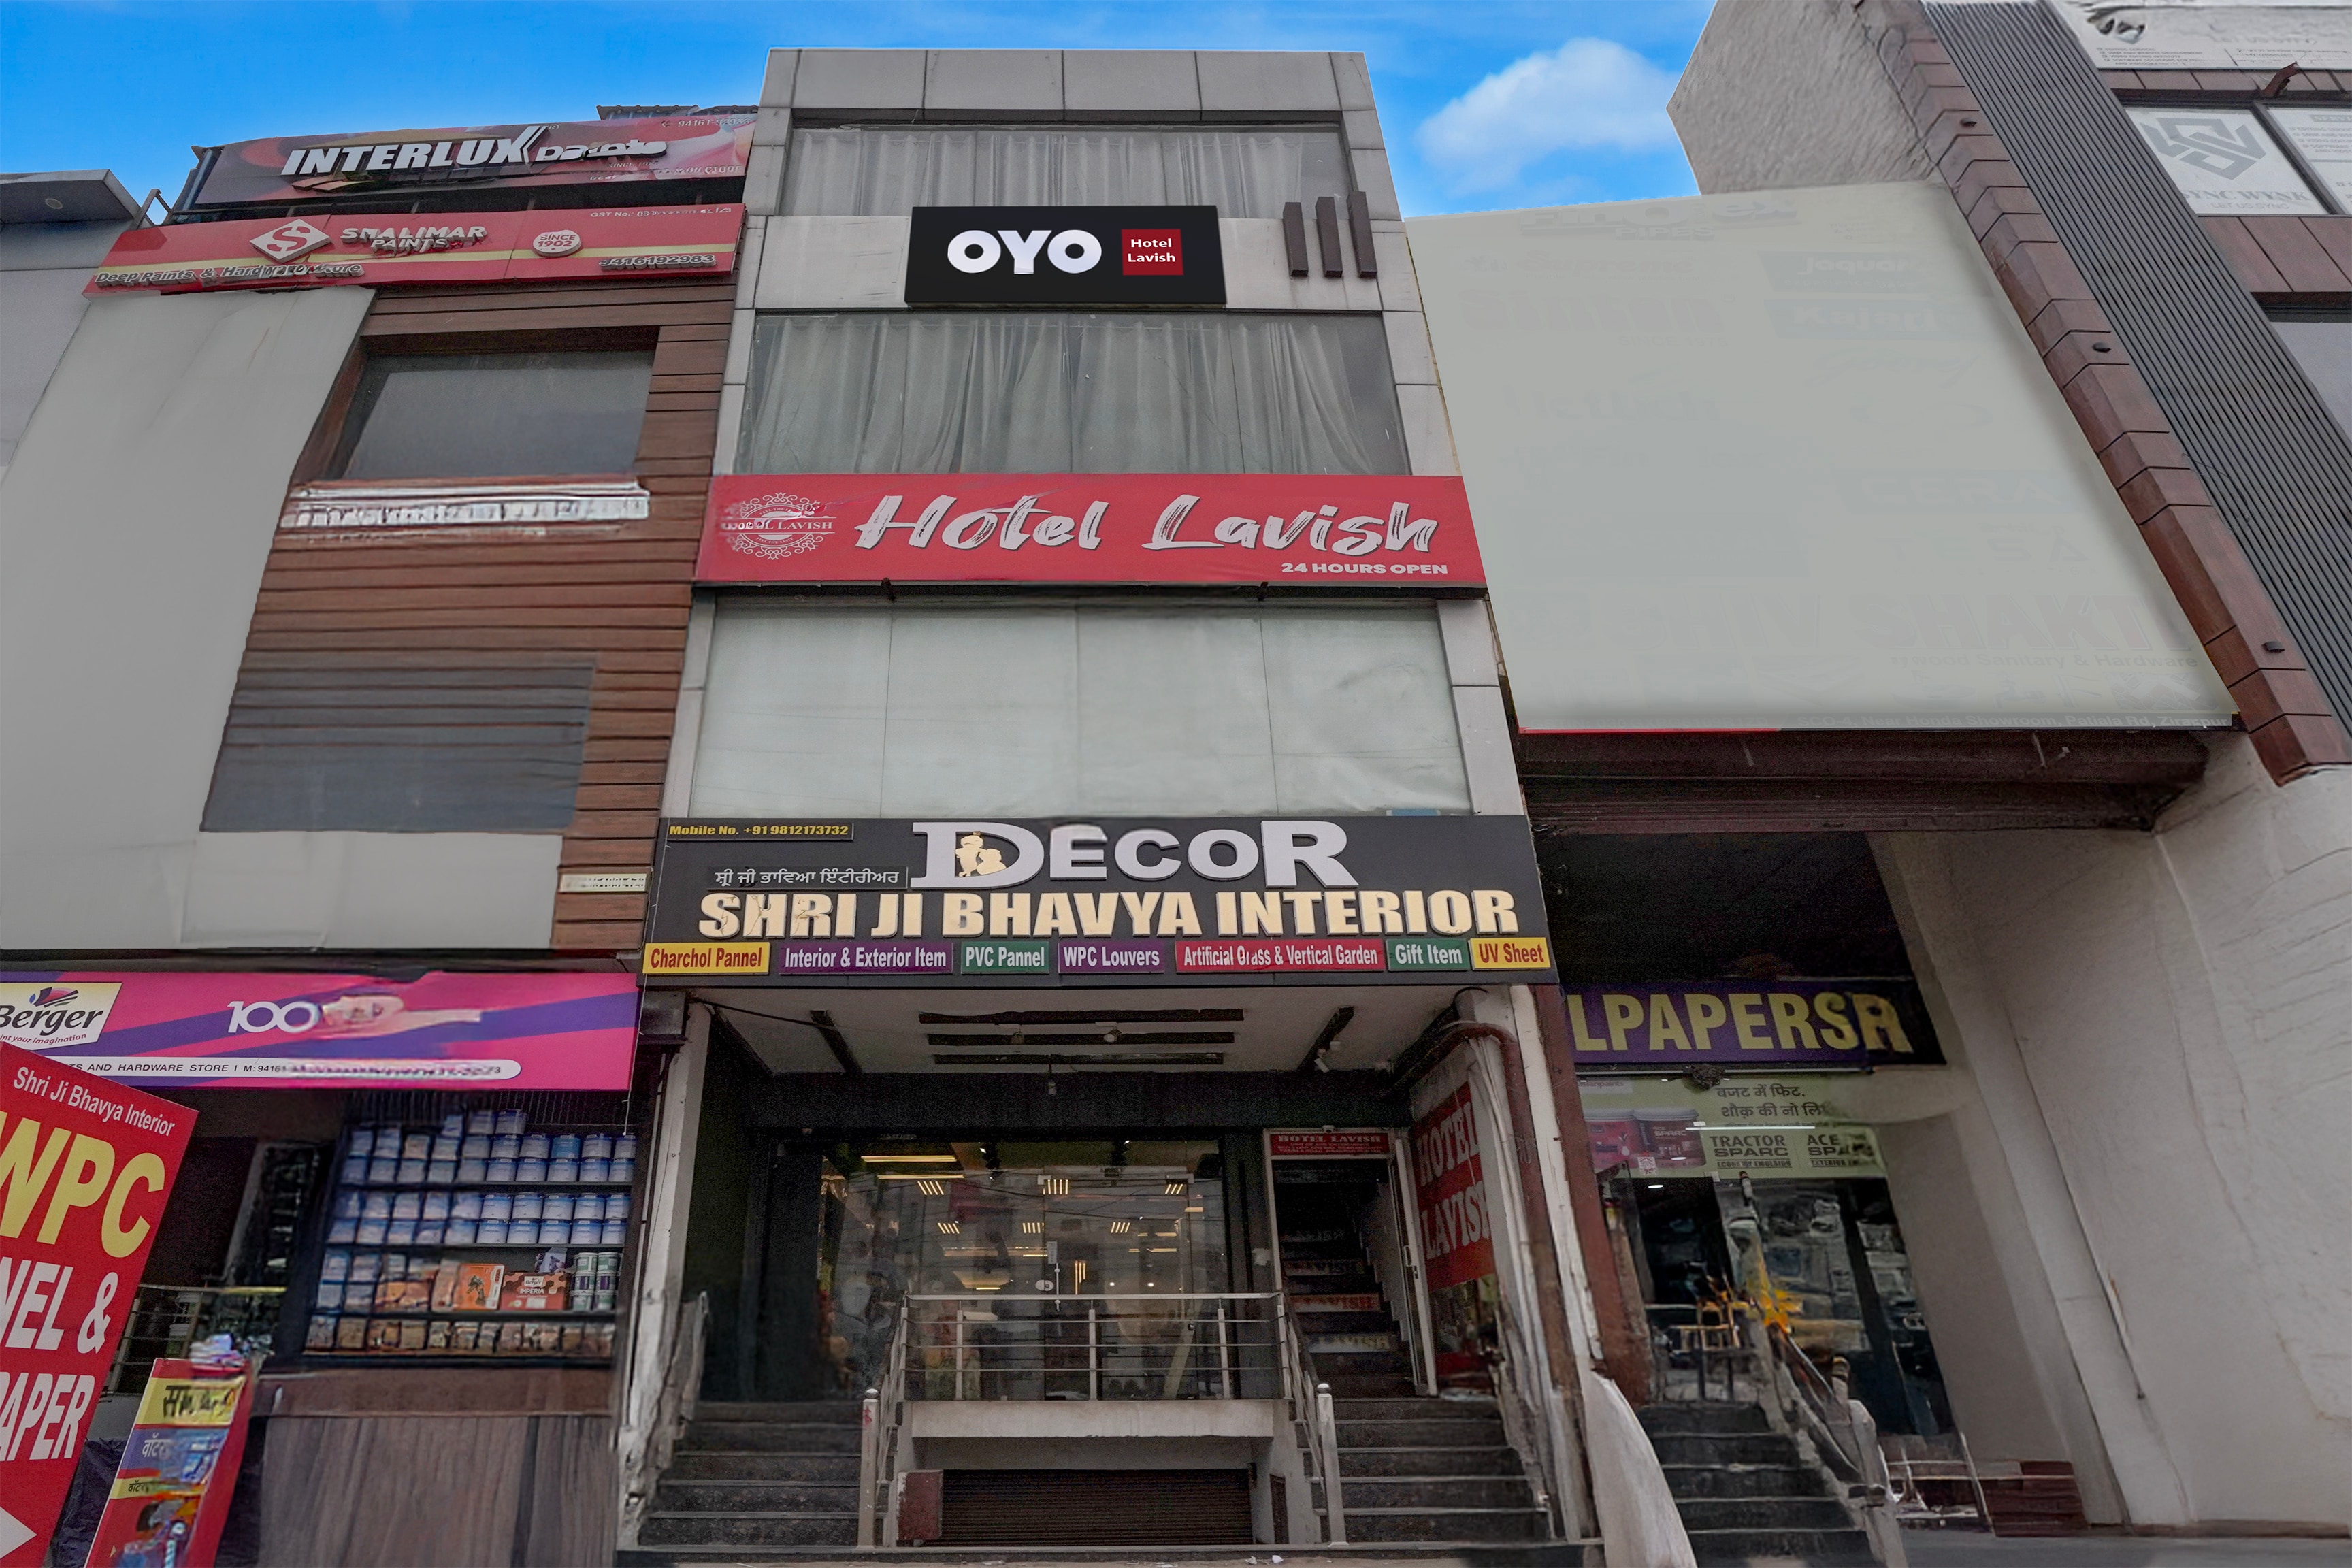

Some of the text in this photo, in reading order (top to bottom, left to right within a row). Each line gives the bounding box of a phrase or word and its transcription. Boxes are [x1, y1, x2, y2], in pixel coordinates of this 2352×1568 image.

[280, 126, 546, 176] INTERLUX
[538, 240, 573, 248] 1902
[540, 233, 576, 242] SINCE
[1130, 238, 1173, 248] Hotel
[947, 229, 1102, 275] OYO
[1127, 252, 1176, 263] Lavish
[95, 272, 140, 284] Deep
[139, 270, 197, 284] Paints
[200, 267, 216, 280] &
[777, 521, 832, 529] LAVISH
[854, 494, 1439, 557] Hotel Lavish
[1281, 563, 1448, 575] 24 HOURS OPEN
[669, 825, 849, 835] Mobile No. +91 9812173732
[699, 890, 1519, 938] SHRI JI BHAVYA INTERIOR
[650, 947, 763, 969] Charchol Pannel
[785, 947, 947, 968] Interior & Exterior Item
[966, 947, 1045, 967] PVC Pannel
[1064, 946, 1160, 967] WPC Louvers
[1183, 946, 1234, 966] Artificial
[1274, 946, 1284, 965] &
[1286, 945, 1333, 965] Vertical
[1335, 945, 1378, 964] Garden
[1395, 943, 1463, 964] Gift Item
[1479, 943, 1544, 964] UV Sheet
[0, 1004, 104, 1036] Berger
[227, 1001, 318, 1033] 100
[32, 1033, 87, 1045] imagination
[118, 1064, 184, 1072] HARDWARE
[189, 1064, 229, 1072] STORE
[13, 1066, 176, 1137] Shri Ji Bhavya Interior
[1710, 1134, 1786, 1147] TRACTOR
[1807, 1134, 1840, 1145] ACE
[1714, 1147, 1789, 1158] SPARC
[0, 1111, 165, 1258] WPC
[77, 1272, 118, 1354] &
[0, 1371, 95, 1462] APER
